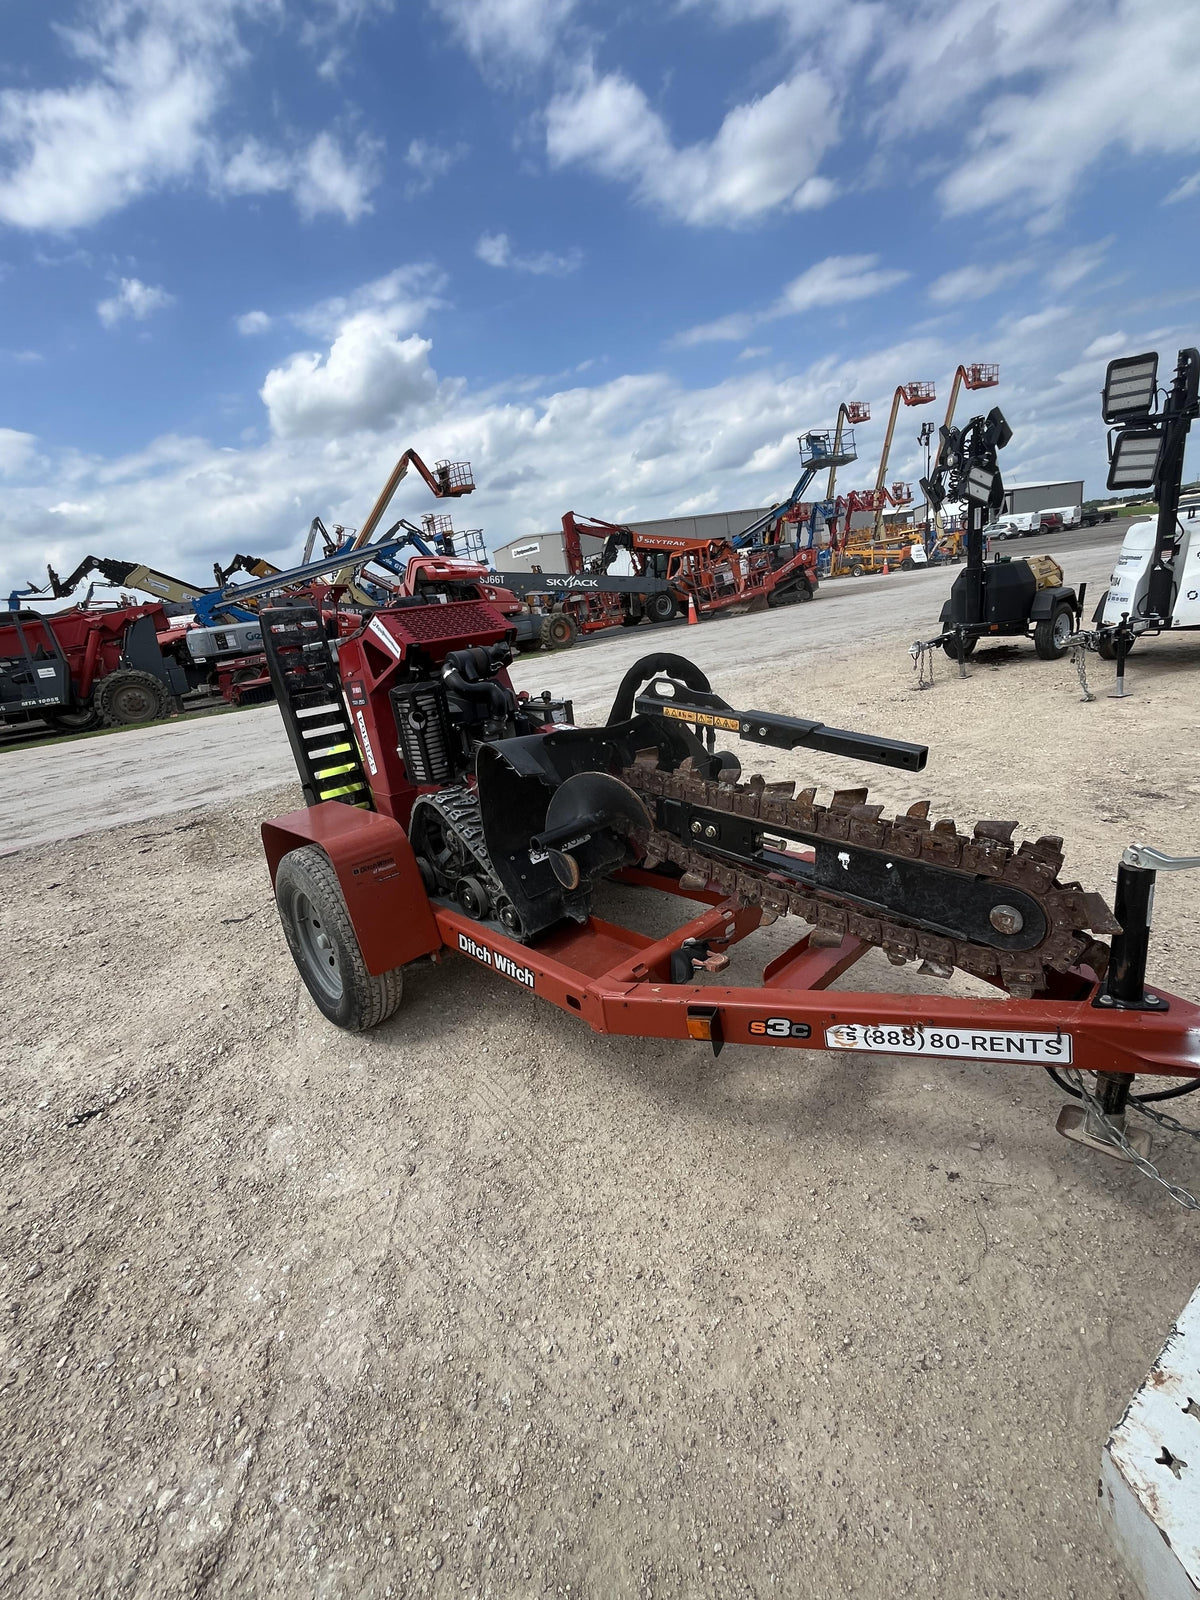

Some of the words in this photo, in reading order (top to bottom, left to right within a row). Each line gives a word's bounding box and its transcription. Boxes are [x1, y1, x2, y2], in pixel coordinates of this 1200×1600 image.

[643, 538, 686, 546] SKYTRAK
[479, 575, 505, 584] SJ66T
[546, 575, 598, 588] SKYJACK
[458, 933, 492, 965] Ditch
[493, 951, 535, 988] Witch
[930, 1033, 1062, 1055] 80-RENTS
